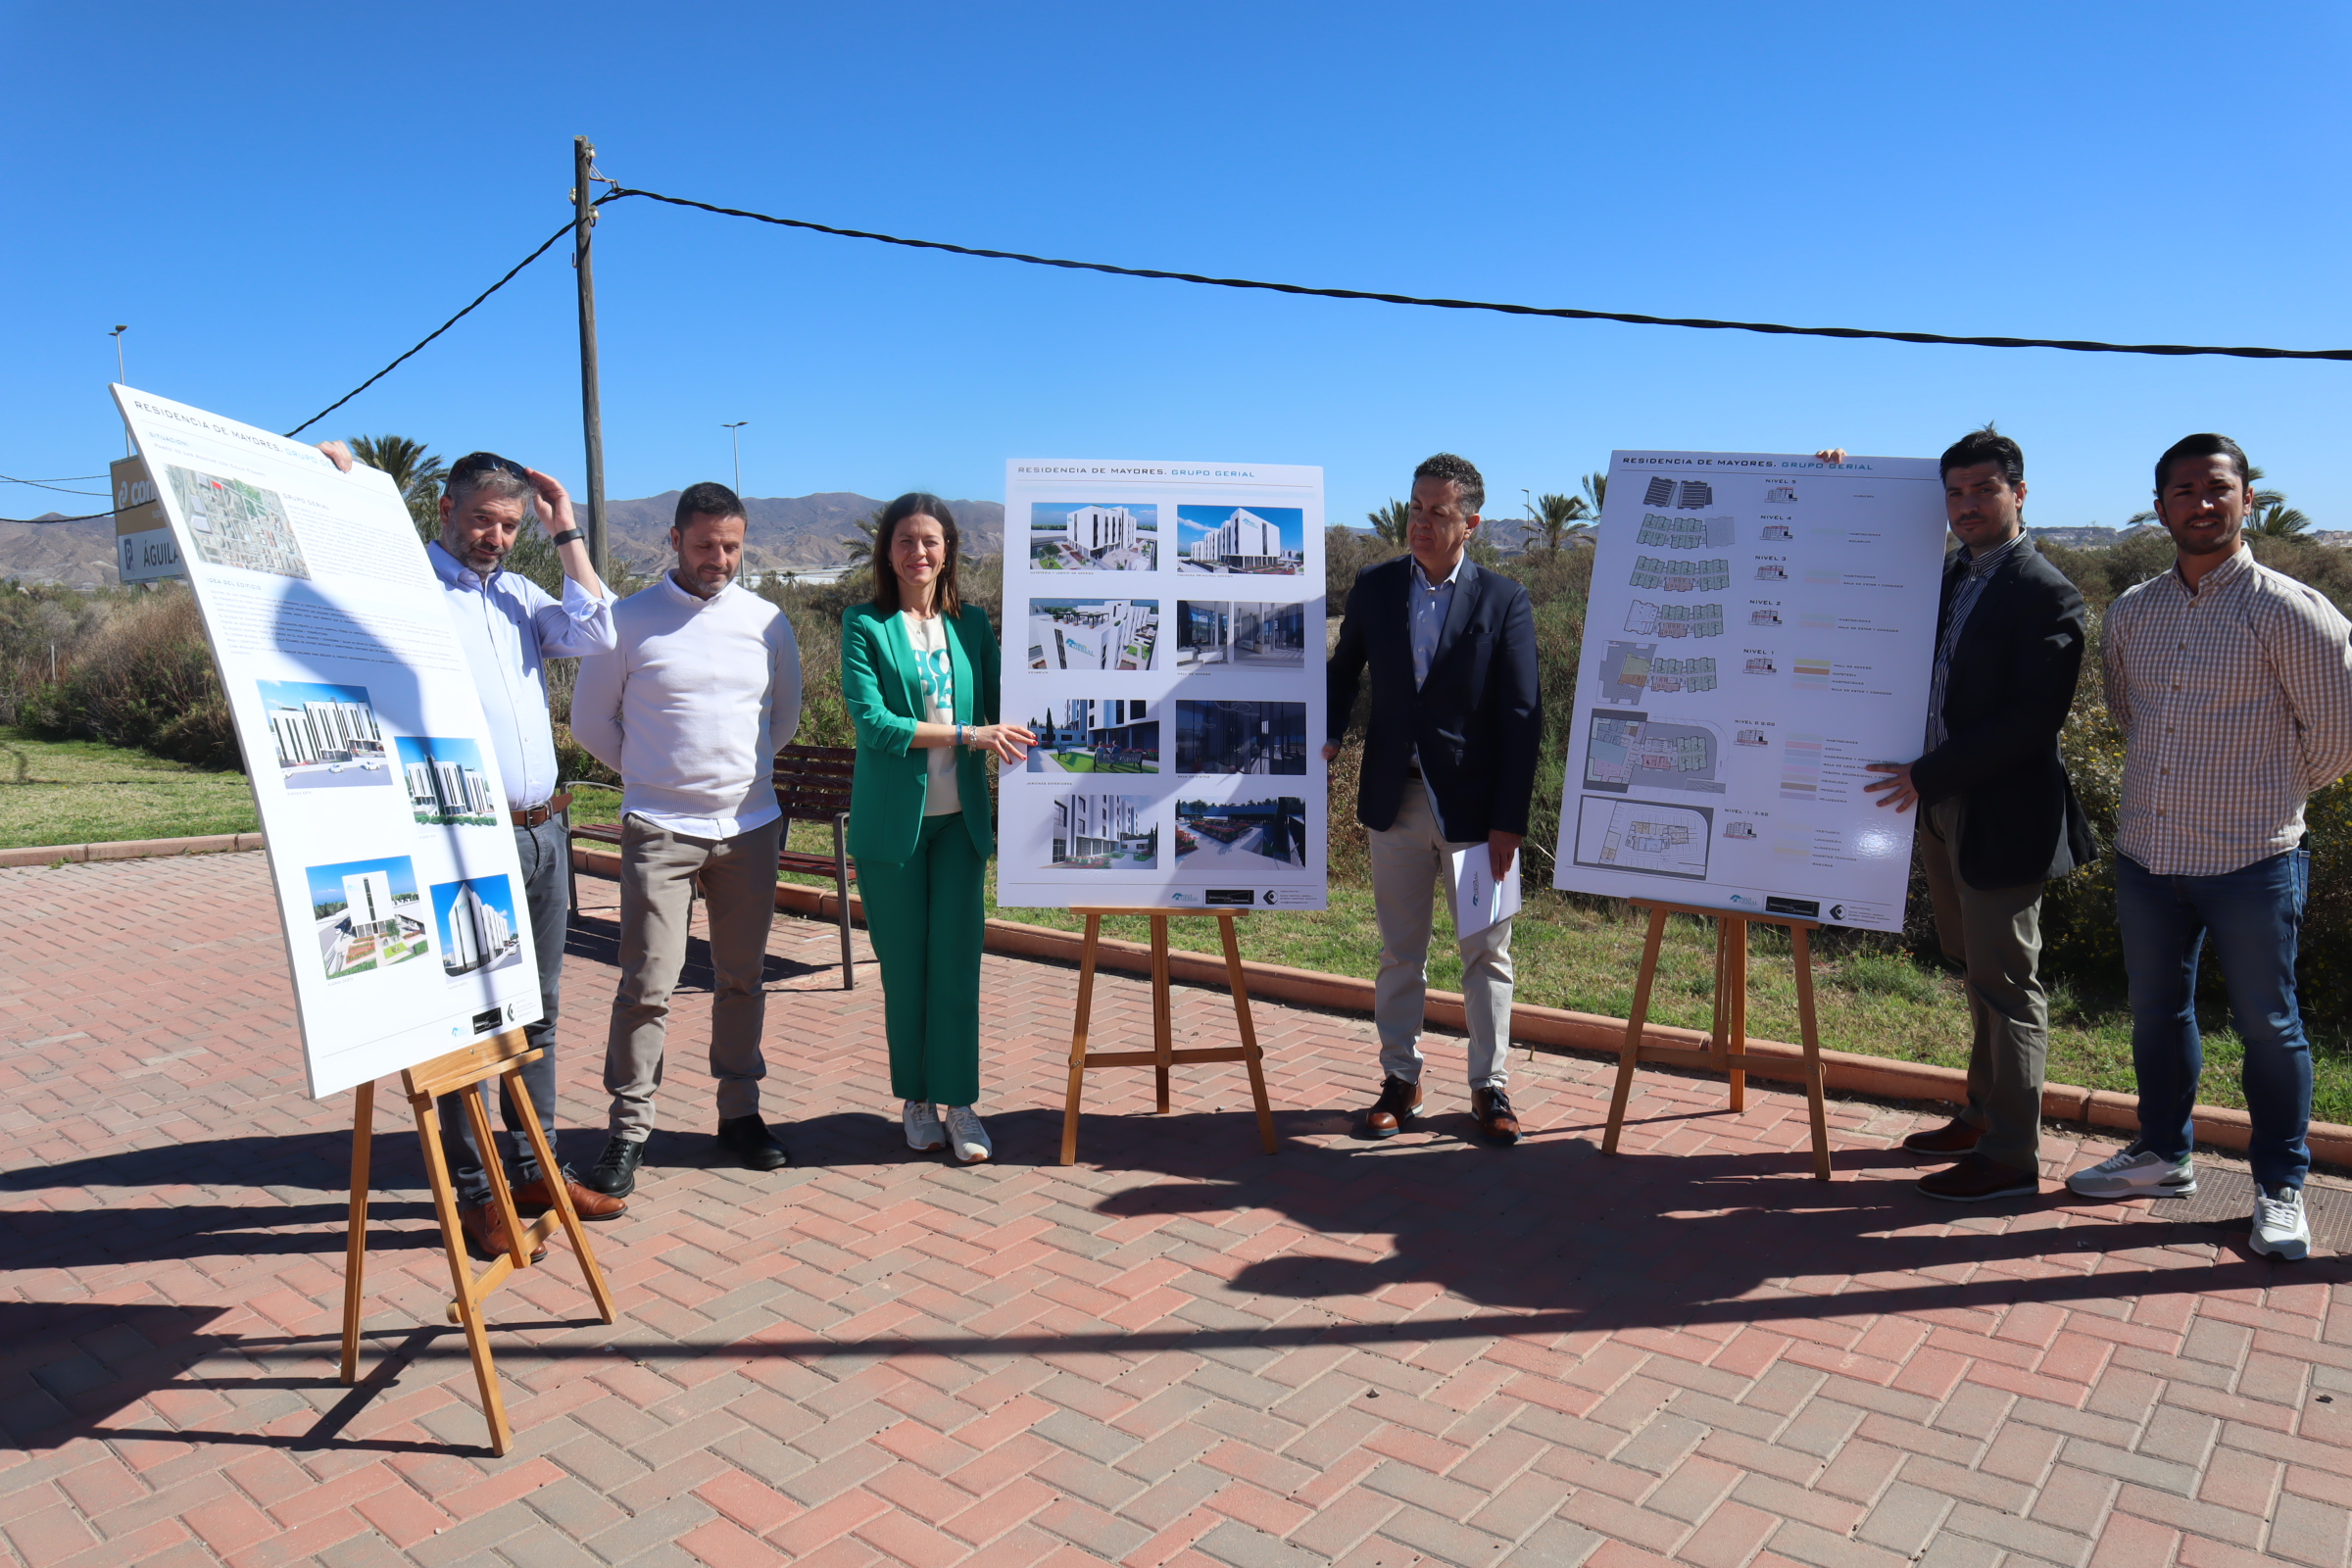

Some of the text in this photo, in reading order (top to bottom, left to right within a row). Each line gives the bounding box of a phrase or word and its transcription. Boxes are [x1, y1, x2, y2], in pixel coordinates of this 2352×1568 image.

[134, 400, 211, 430] RESIDENCIA
[212, 423, 229, 436] DE
[230, 429, 283, 453] MAYORES.
[284, 447, 318, 465] GRUPO
[1622, 457, 1693, 466] RESIDENCIA
[1717, 459, 1777, 467] MAYORES.
[1781, 461, 1824, 469] GRUPO
[1829, 462, 1874, 470] GERIAL
[1214, 469, 1255, 478] GERIAL
[282, 492, 330, 511] GRUPO GERIAL
